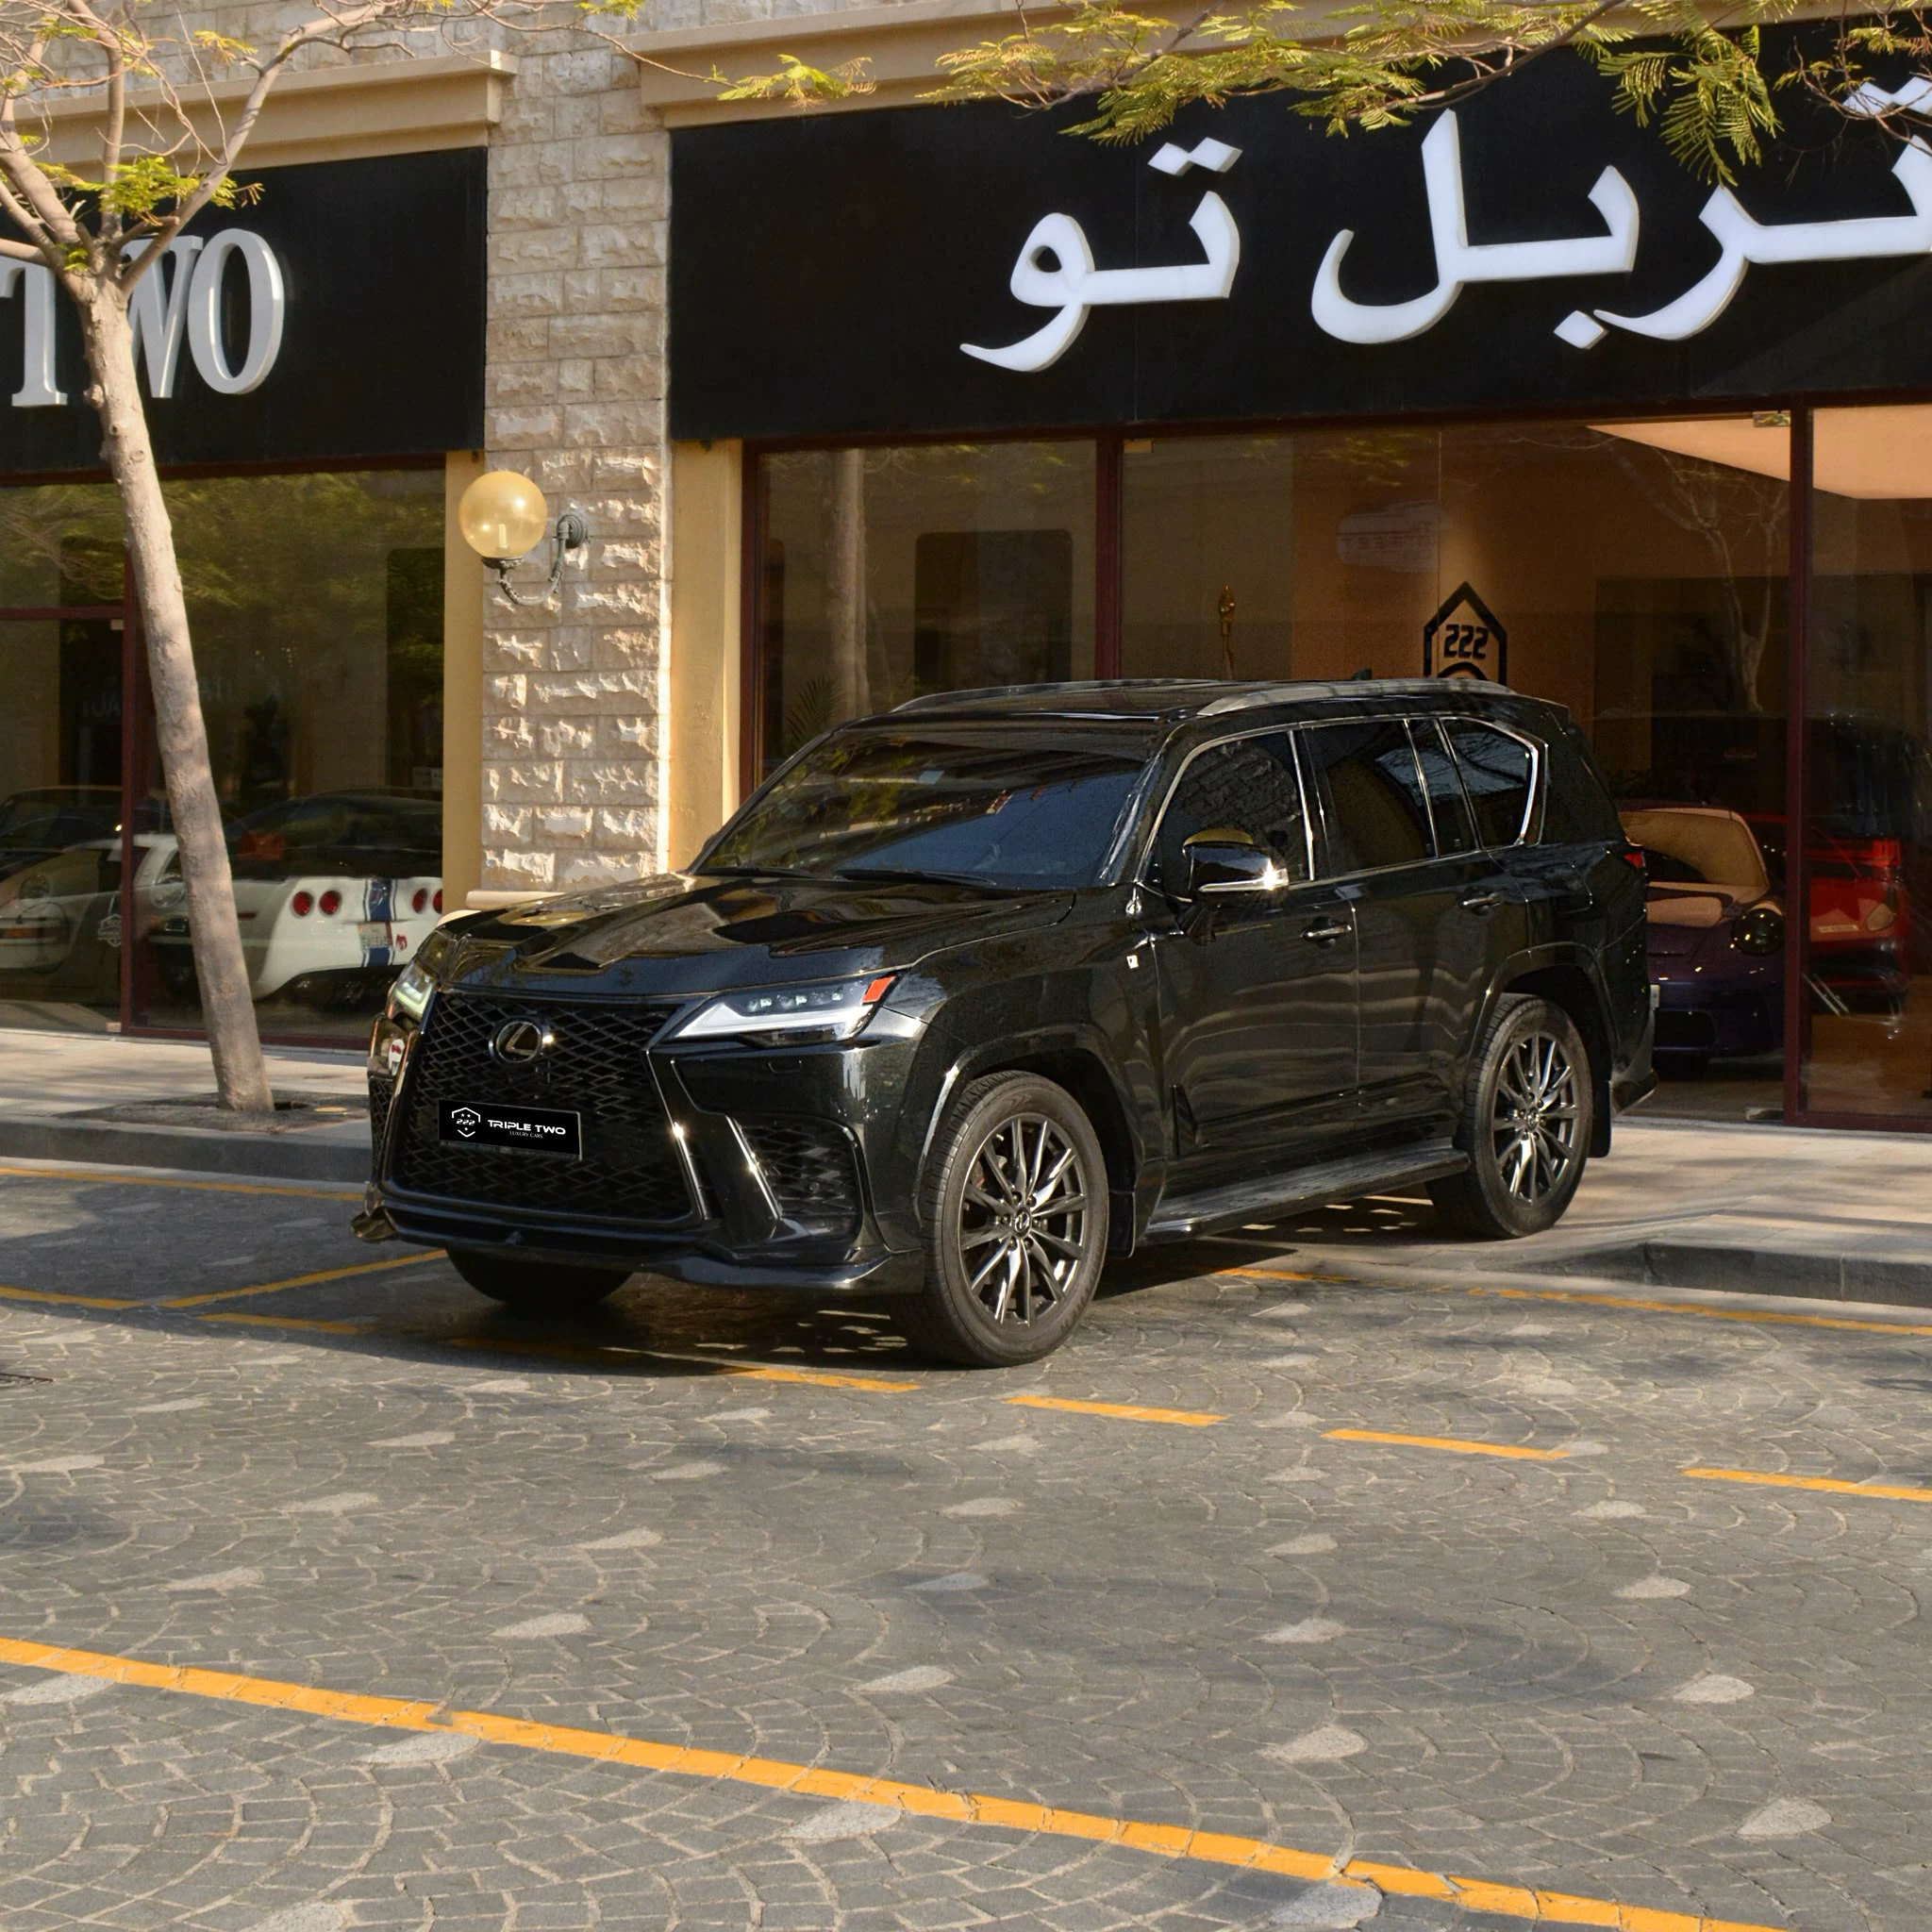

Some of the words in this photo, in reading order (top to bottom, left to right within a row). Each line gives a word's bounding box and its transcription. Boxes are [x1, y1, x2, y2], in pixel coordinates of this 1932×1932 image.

[959, 135, 1242, 372] تو
[1442, 624, 1490, 659] 222
[488, 1120, 531, 1131] TRIPLE
[535, 1124, 566, 1135] TWO
